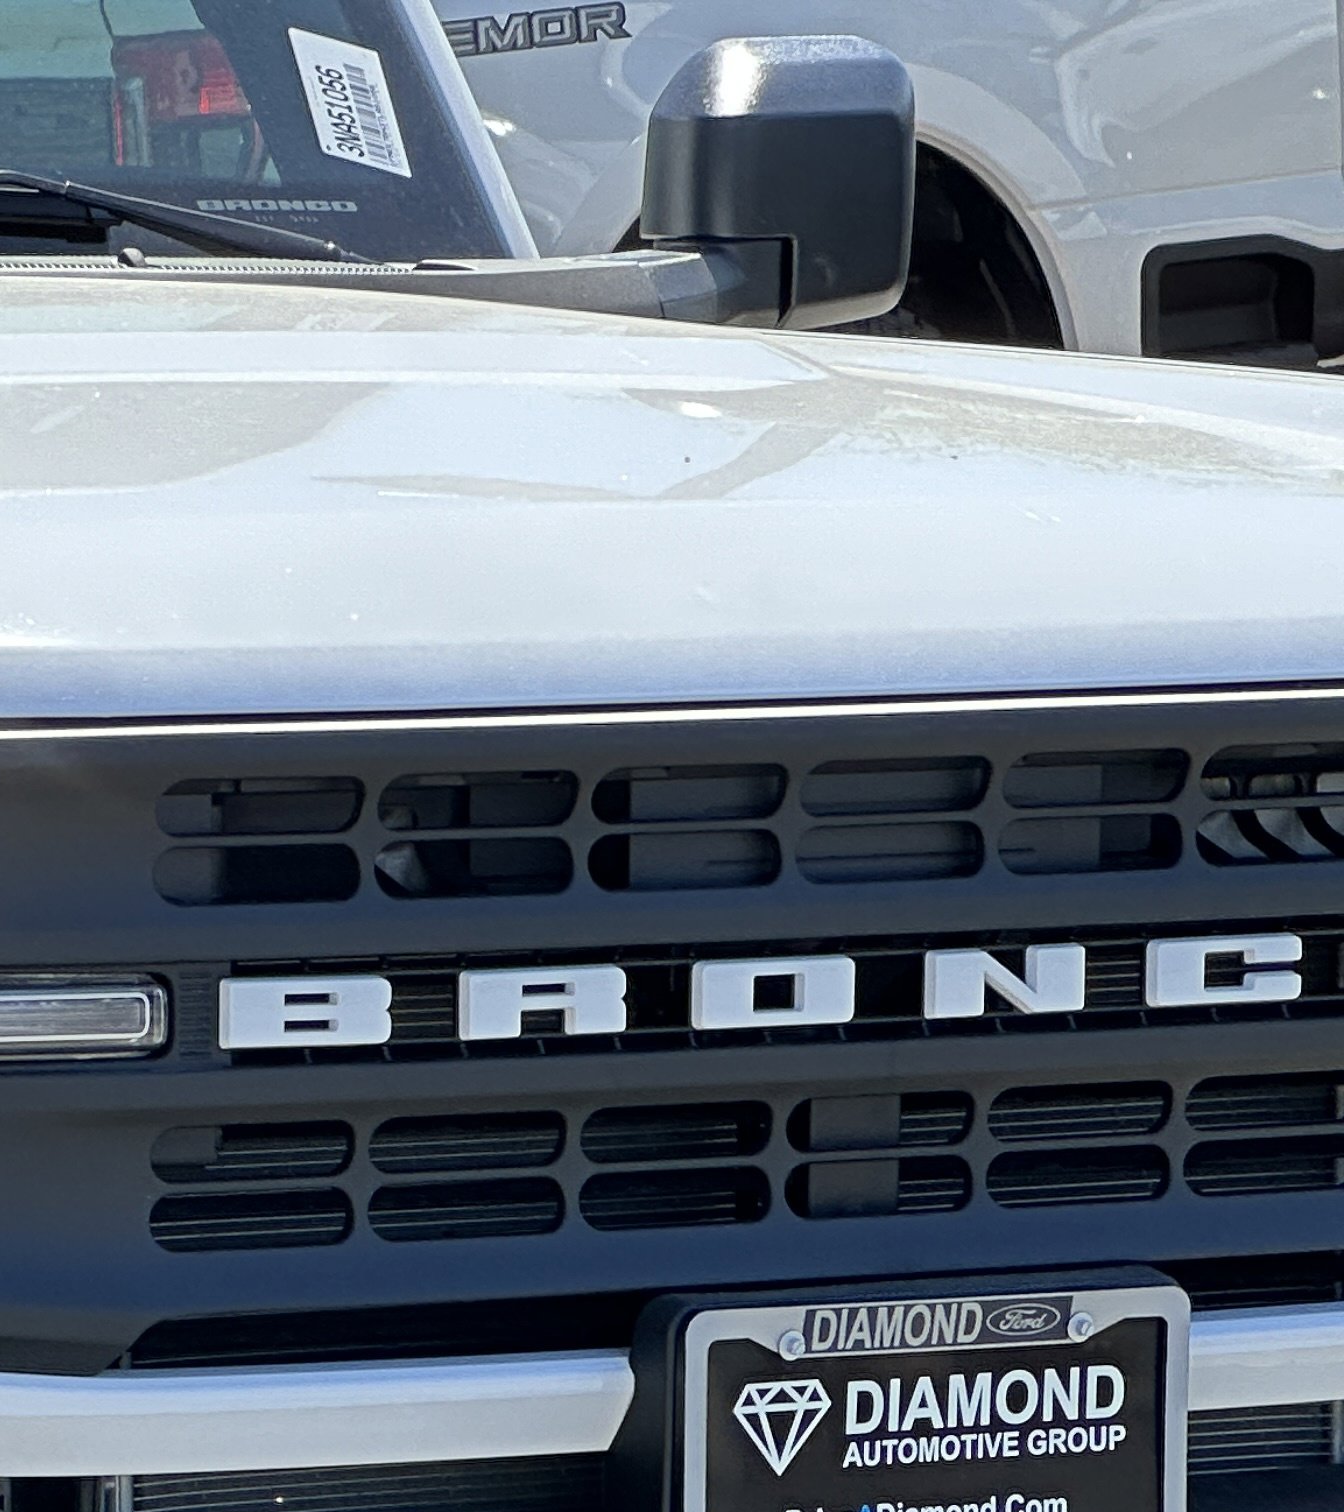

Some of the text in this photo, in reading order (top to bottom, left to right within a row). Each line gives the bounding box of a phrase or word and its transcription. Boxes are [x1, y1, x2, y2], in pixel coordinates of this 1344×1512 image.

[315, 65, 365, 157] 3NA51056
[197, 199, 358, 213] BRONCO
[218, 932, 1344, 1050] BRONC
[814, 1301, 1047, 1351] DIAMOND Ford
[845, 1364, 1126, 1436] DIAMOND
[842, 1424, 1127, 1468] AUTOMOTIVE GROUP
